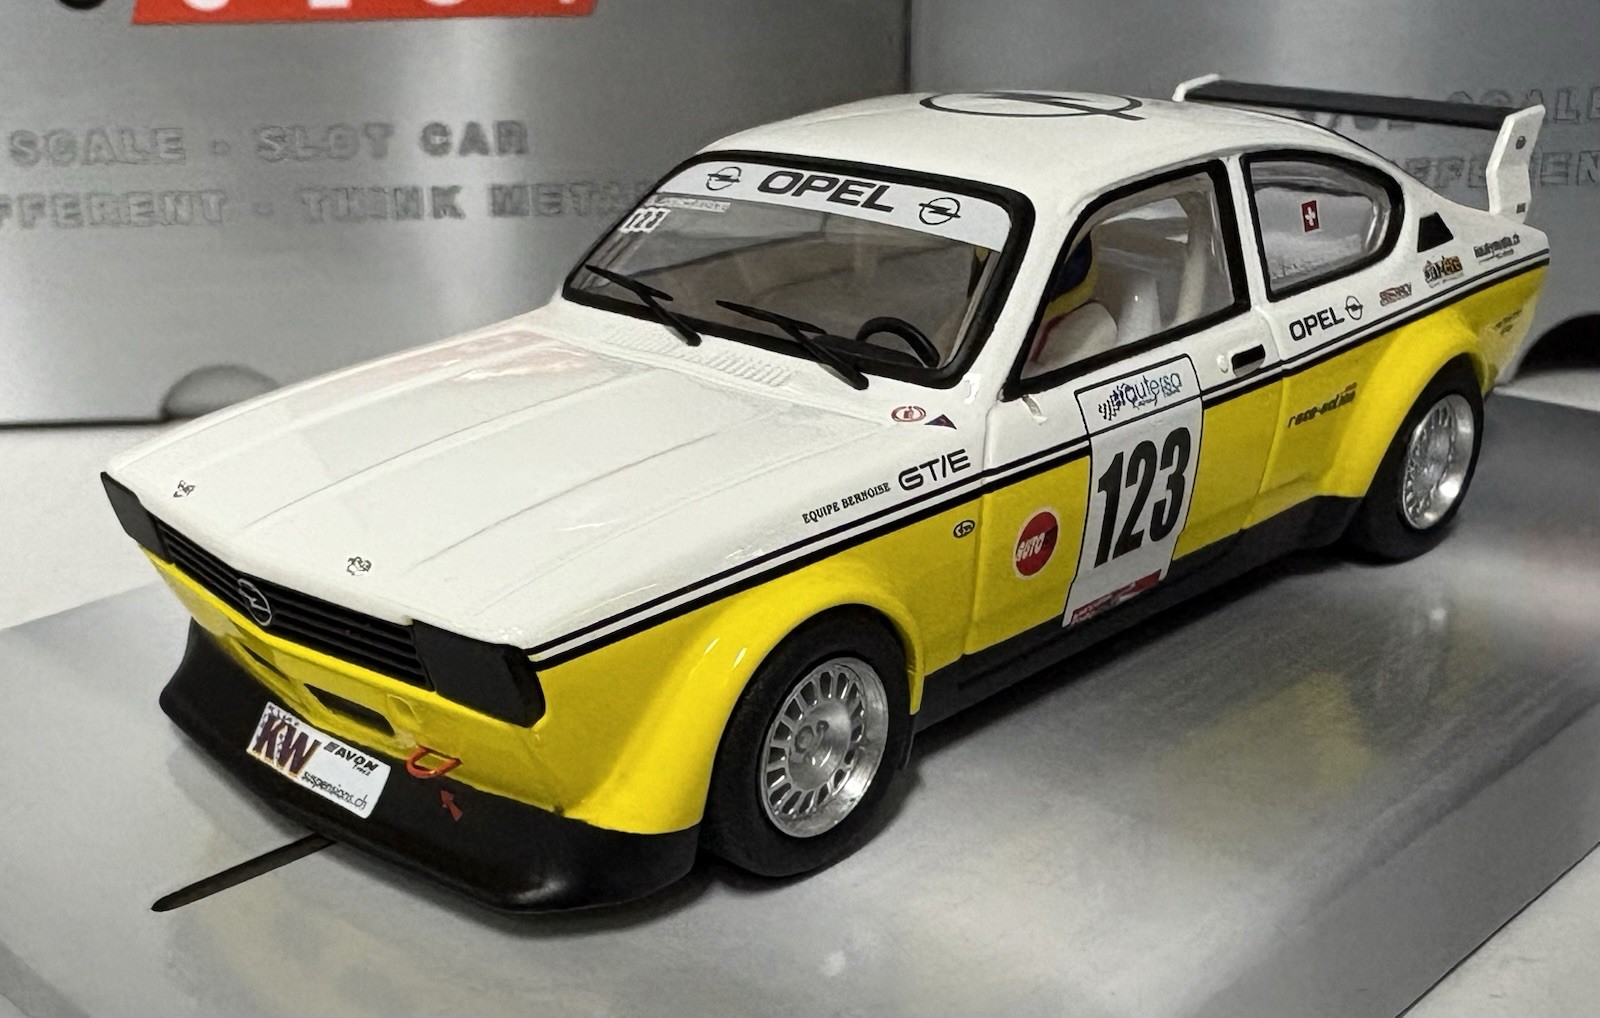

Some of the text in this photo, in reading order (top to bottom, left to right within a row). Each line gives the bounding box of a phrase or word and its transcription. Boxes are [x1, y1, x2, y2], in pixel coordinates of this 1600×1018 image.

[8, 119, 530, 168] SCALE SLOT CAR
[300, 182, 467, 224] THINK
[756, 169, 895, 214] OPEL
[1288, 306, 1346, 342] OPEL
[898, 448, 972, 491] GT/E
[801, 481, 892, 525] EQUIPE BERNOISE
[1093, 426, 1191, 569] 123
[252, 714, 322, 777] KW
[334, 746, 379, 772] AVON
